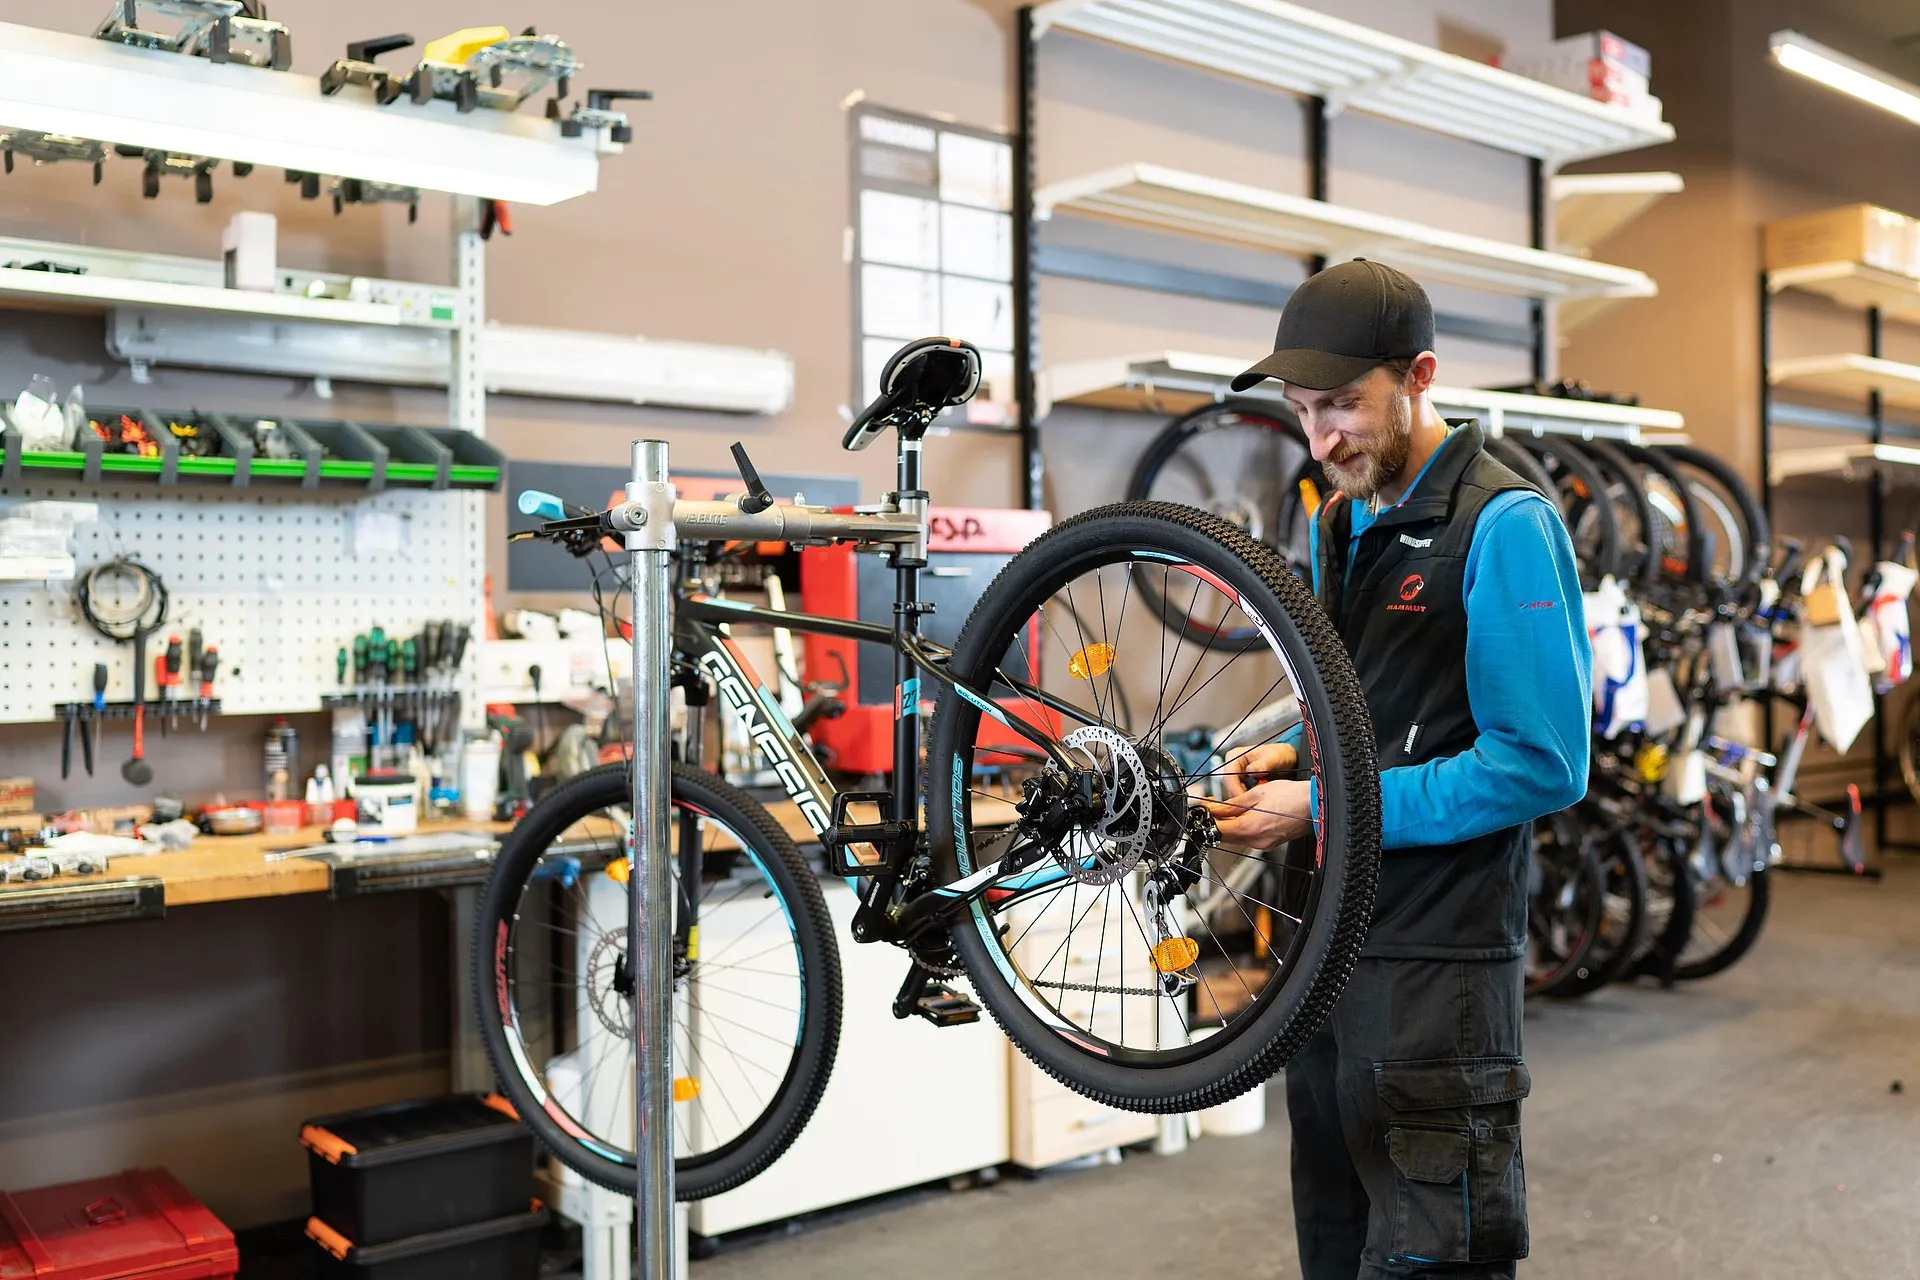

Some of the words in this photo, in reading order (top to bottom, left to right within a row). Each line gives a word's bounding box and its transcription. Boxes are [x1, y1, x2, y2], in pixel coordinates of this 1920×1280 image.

[1386, 604, 1426, 612] MAMMUT
[957, 688, 992, 714] SOLUTION
[701, 650, 832, 835] GENESIS
